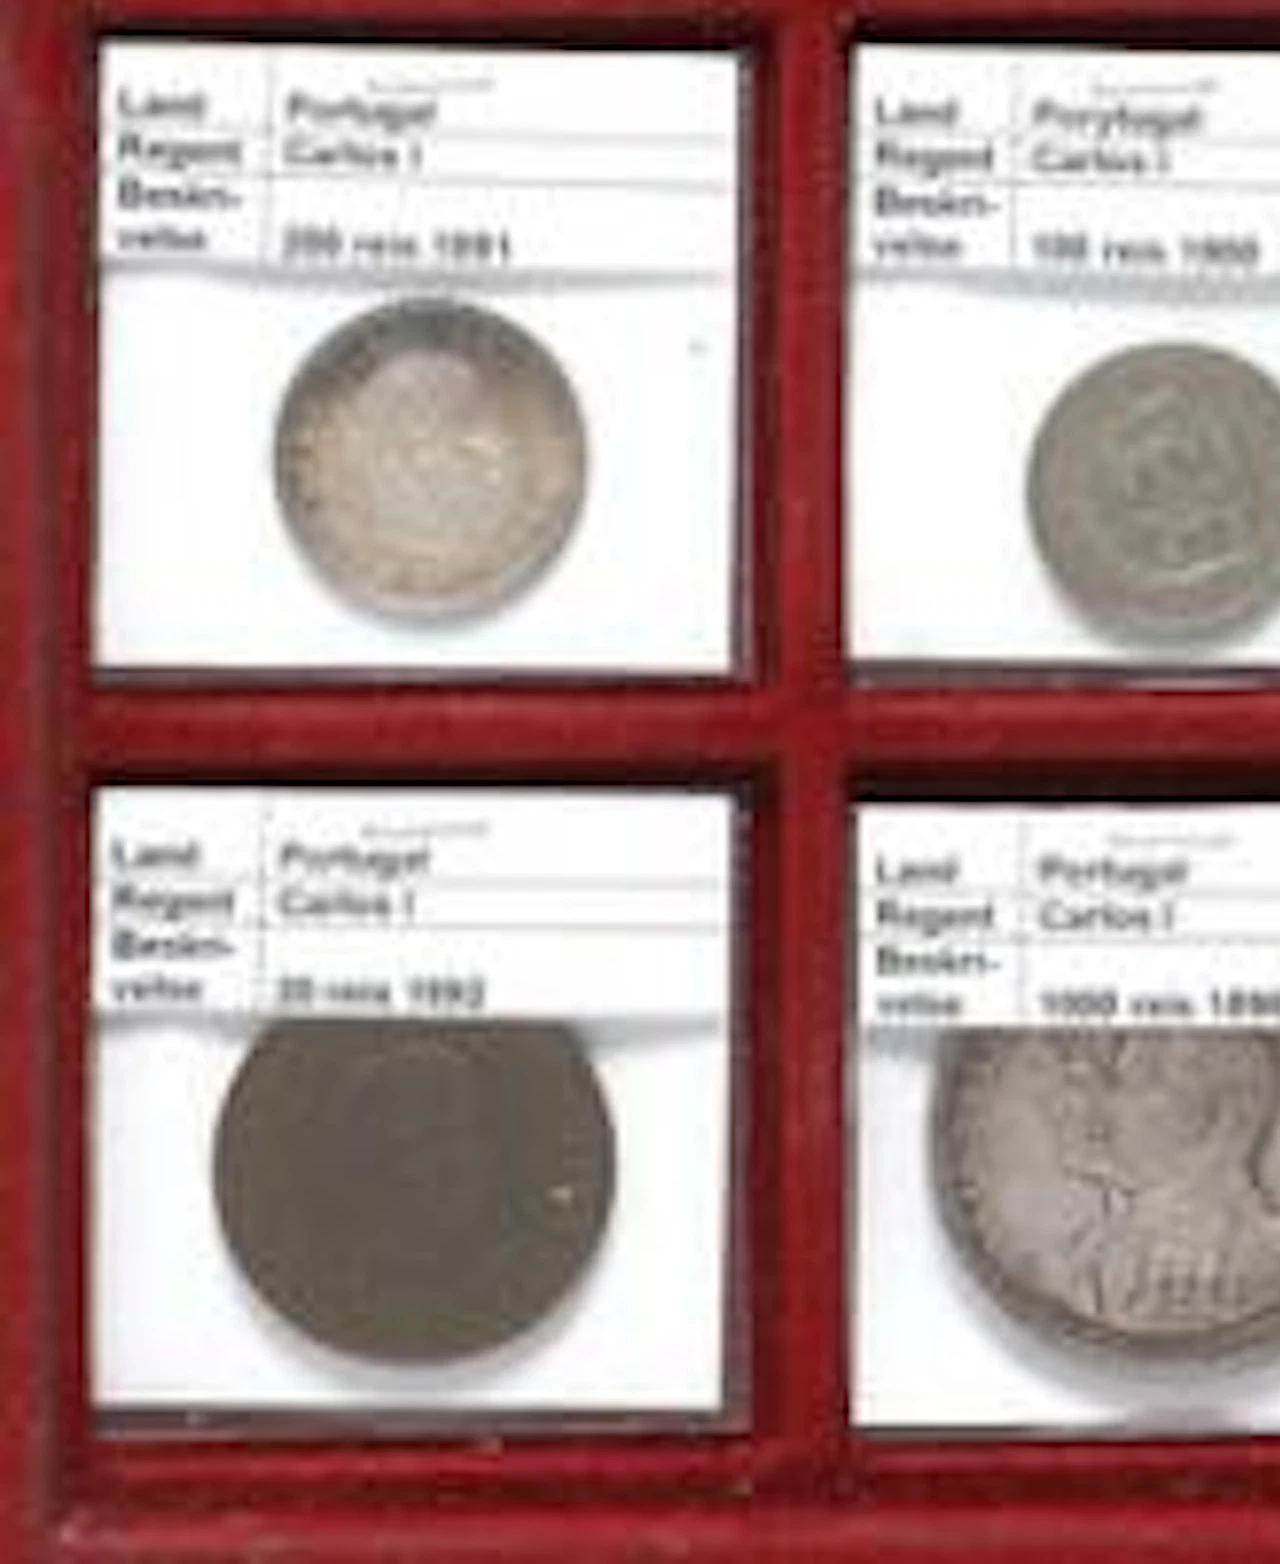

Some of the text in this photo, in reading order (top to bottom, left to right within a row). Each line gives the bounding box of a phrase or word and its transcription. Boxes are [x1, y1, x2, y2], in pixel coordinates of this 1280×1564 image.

[116, 89, 207, 122] Land
[285, 91, 437, 136] Portugal
[873, 97, 960, 129] Land
[116, 130, 243, 174] Regent
[283, 136, 400, 170] Carlos
[873, 138, 996, 181] Regent
[1032, 143, 1148, 176] Carlos
[117, 224, 208, 252] velse
[873, 232, 962, 260] velse
[109, 840, 201, 873] Land
[278, 841, 431, 883] Portugal
[874, 857, 960, 888] Land
[1036, 854, 1189, 895] Portugal
[110, 881, 236, 924] Regent
[277, 886, 392, 919] Carlos
[874, 897, 996, 940] Regent
[1038, 899, 1153, 933] Carlos
[112, 972, 203, 1004] velse
[876, 990, 963, 1019] velse
